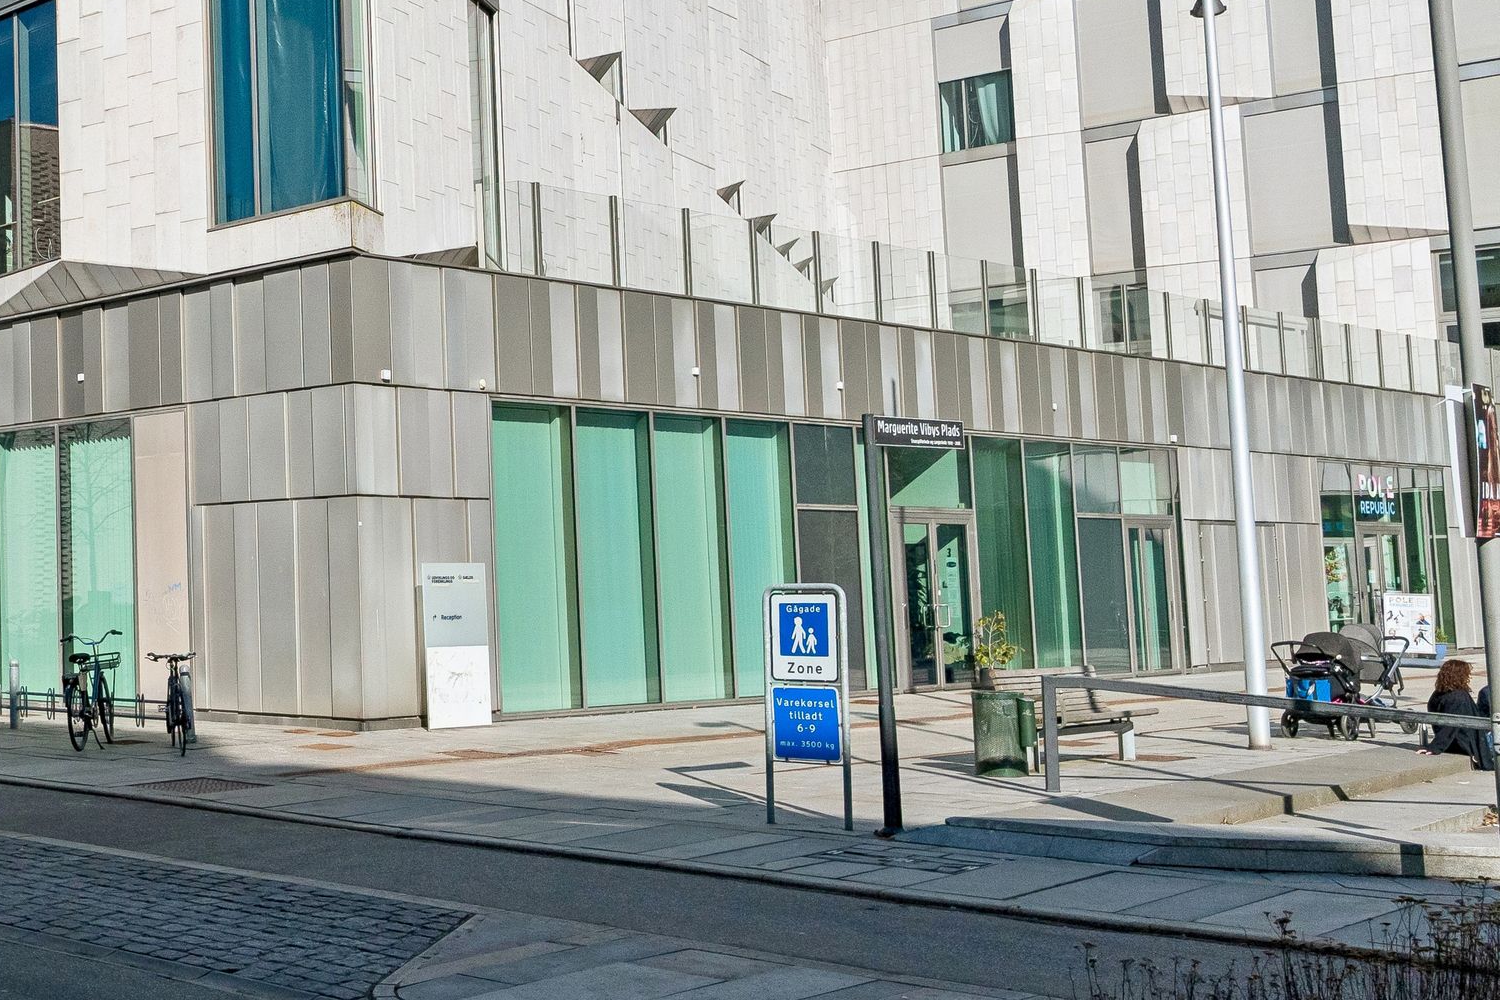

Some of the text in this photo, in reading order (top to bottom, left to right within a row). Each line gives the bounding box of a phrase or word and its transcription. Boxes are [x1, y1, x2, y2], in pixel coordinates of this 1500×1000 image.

[877, 420, 961, 438] Marguerite Vibys Plads
[1358, 474, 1394, 498] POLE
[1360, 501, 1396, 515] REPUBLIC
[786, 604, 821, 614] Gågade
[787, 662, 823, 674] Zone
[776, 698, 834, 709] Varekørsel
[789, 711, 823, 720] tilladt
[797, 723, 816, 733] 6-9
[801, 740, 822, 748] 3500
[825, 742, 835, 751] kg
